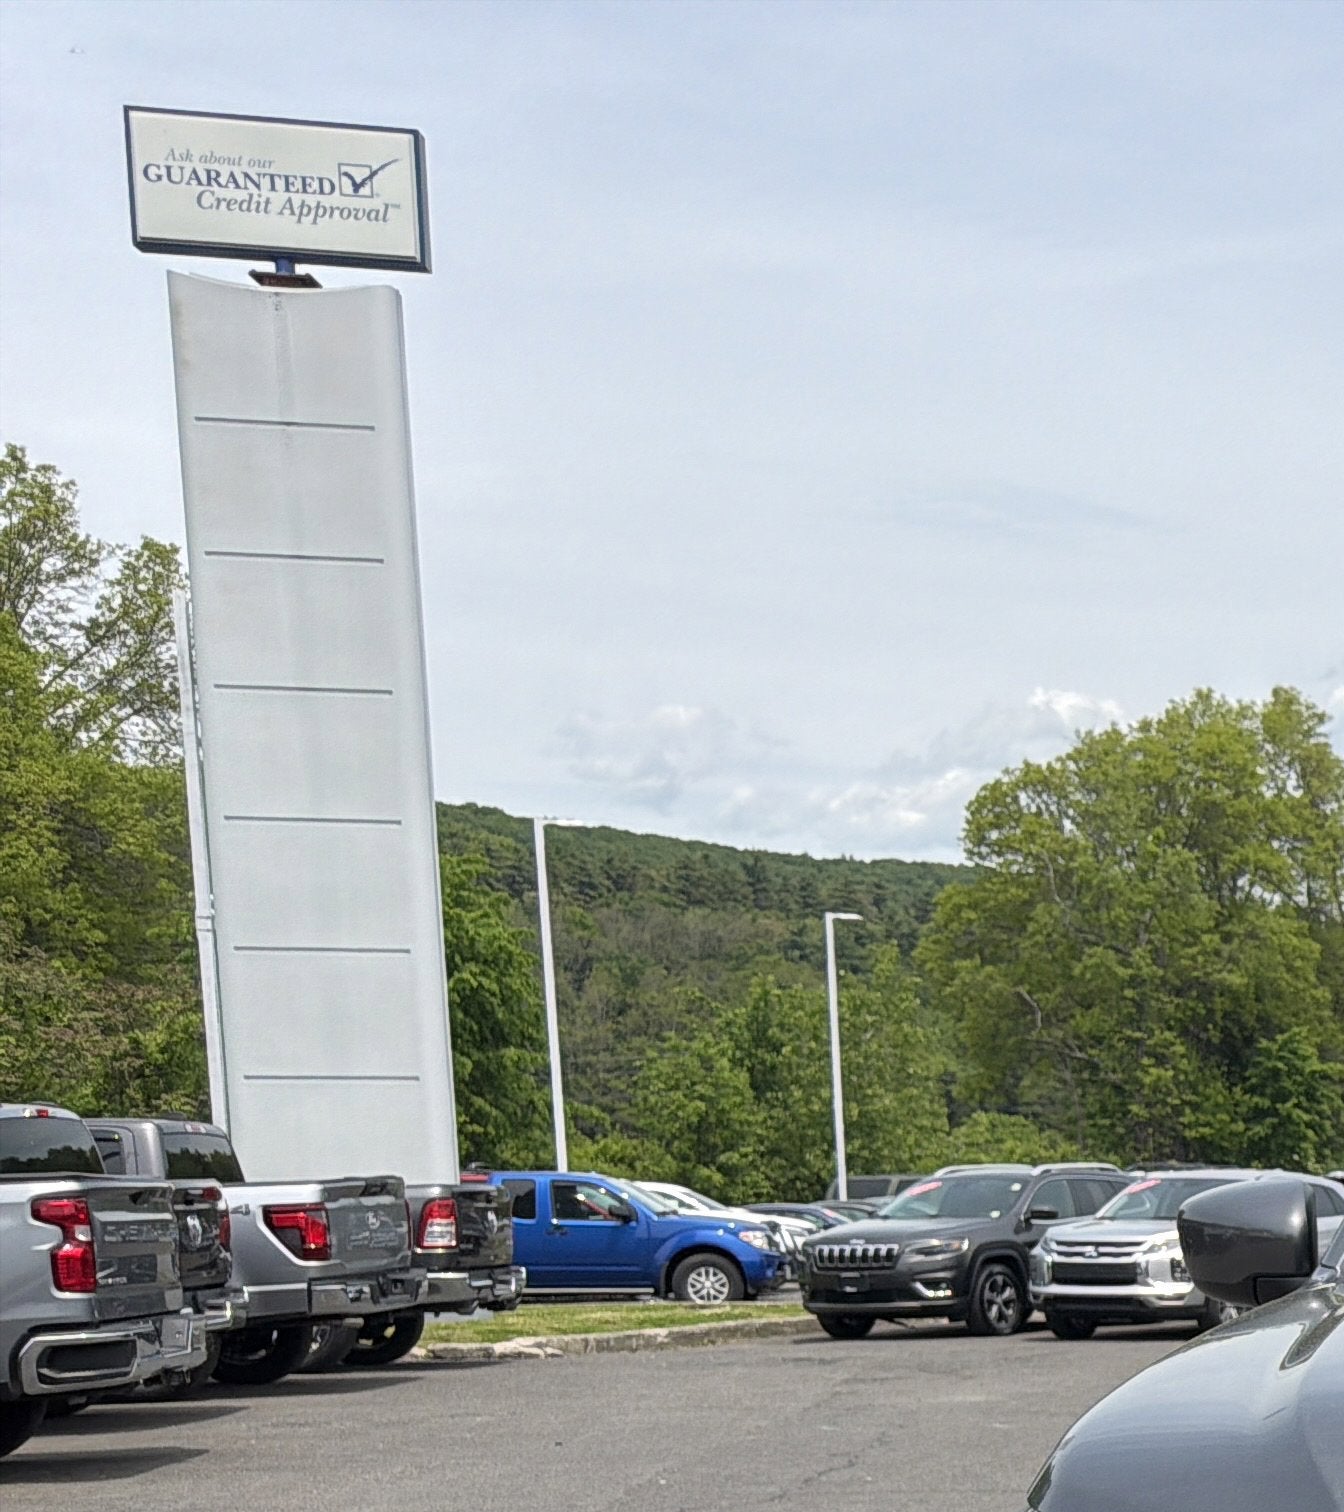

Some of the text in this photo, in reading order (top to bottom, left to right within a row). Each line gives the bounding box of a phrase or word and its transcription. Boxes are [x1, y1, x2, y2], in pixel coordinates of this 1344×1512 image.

[164, 147, 276, 169] Ask about our
[142, 163, 336, 196] GUARANTEED
[196, 189, 272, 215] Credit
